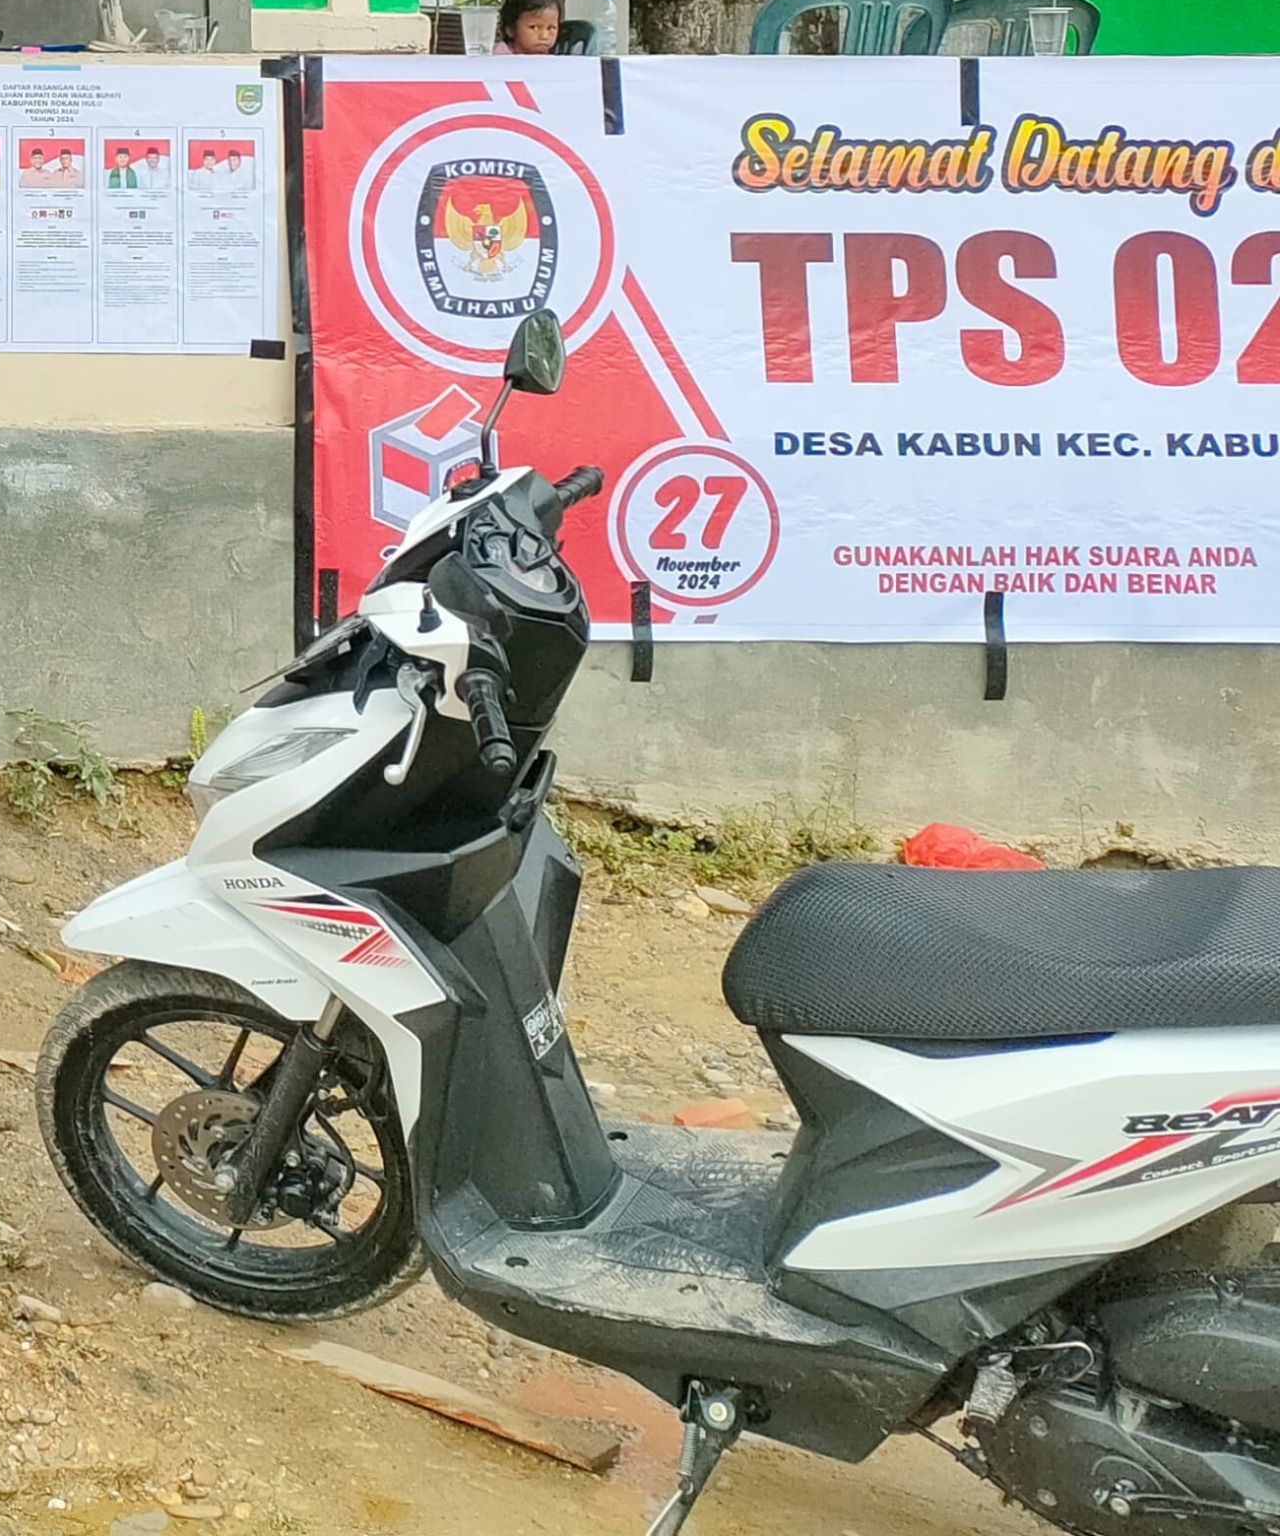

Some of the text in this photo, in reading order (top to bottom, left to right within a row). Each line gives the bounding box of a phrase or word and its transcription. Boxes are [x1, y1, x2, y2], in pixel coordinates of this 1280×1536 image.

[48, 128, 55, 136] 3
[134, 129, 140, 137] 4
[220, 130, 226, 138] 5
[444, 161, 525, 178] KOMISI
[733, 114, 1280, 217] Selamat Datang d
[420, 248, 555, 315] PEMILIHAN UMUM
[730, 230, 1066, 387] TPS
[774, 432, 1280, 458] DESA KABUN KEC. KABU
[648, 475, 748, 550] 27
[656, 556, 742, 573] November
[833, 545, 1259, 568] GUNAKANLAH HAK SUARA ANDA
[676, 574, 722, 590] 2024
[878, 573, 1218, 594] DENGAN BAIK DAN BENAR
[224, 877, 285, 890] HONDA
